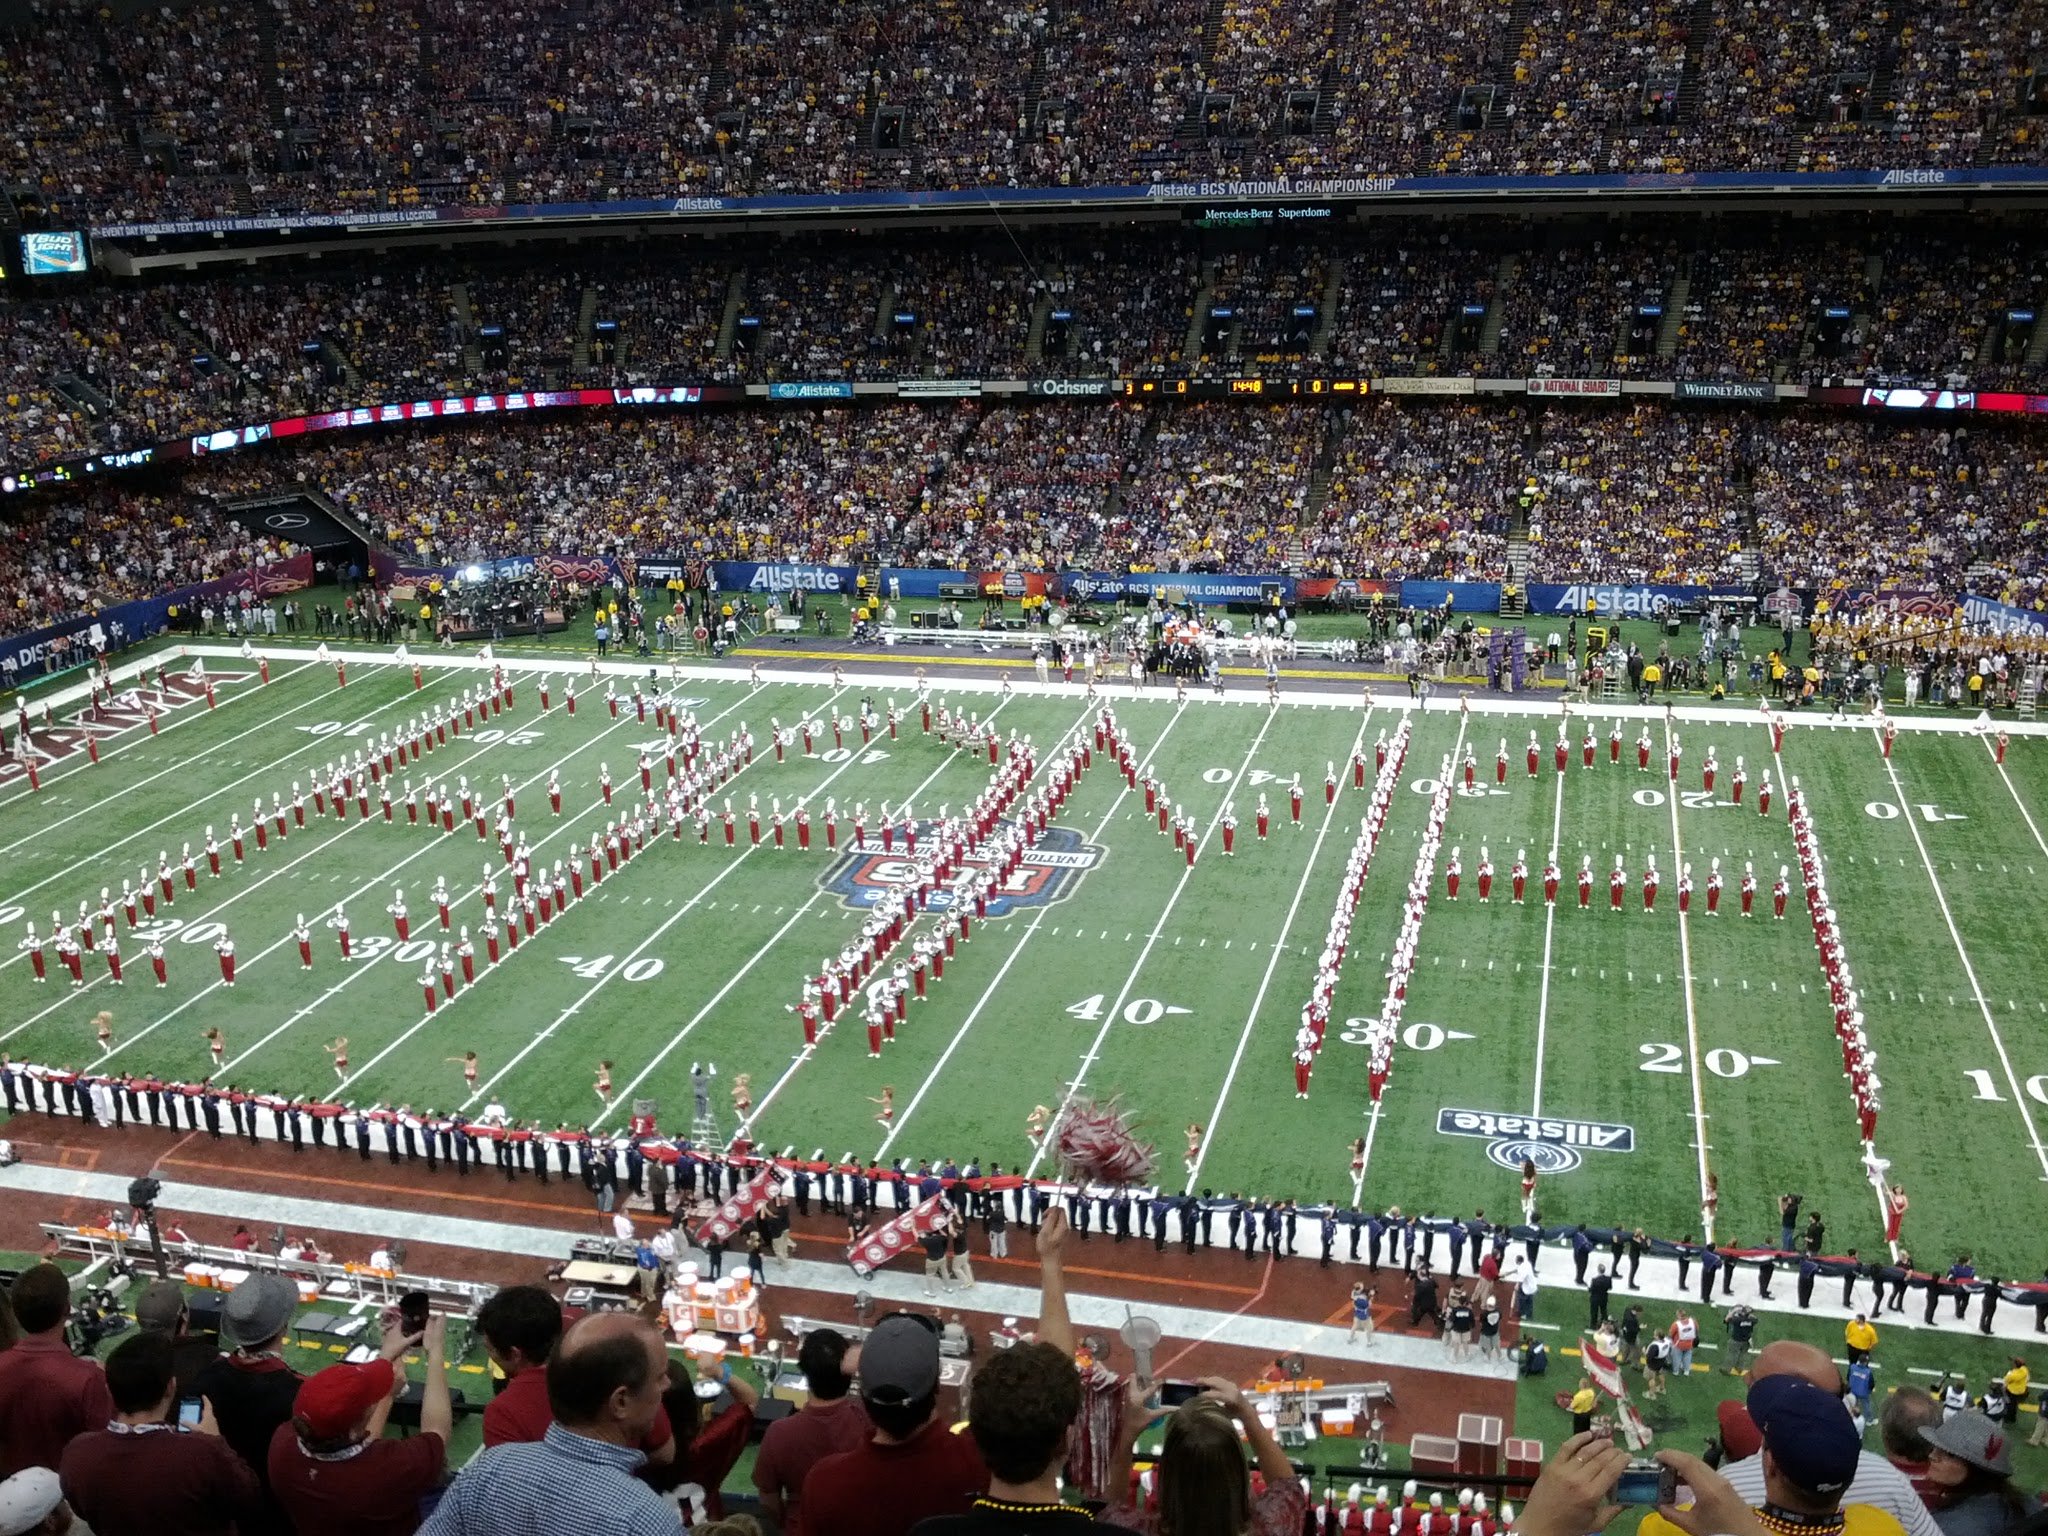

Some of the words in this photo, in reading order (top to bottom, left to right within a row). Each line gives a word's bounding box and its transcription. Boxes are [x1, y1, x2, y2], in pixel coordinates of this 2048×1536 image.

[1881, 169, 1945, 184] Allstate
[1146, 183, 1197, 197] Allstate
[1200, 182, 1226, 195] BCS
[1228, 180, 1293, 195] NATIONAL
[1295, 178, 1396, 193] CHAMPIONSHIP
[674, 197, 723, 210] Allstate
[1205, 208, 1273, 219] Mercedes-Benz
[1278, 207, 1331, 219] Superdome
[176, 222, 194, 233] TEXT
[195, 222, 205, 232] TO
[334, 214, 368, 225] FOLLOWED
[369, 214, 379, 223] BY
[406, 210, 437, 221] LOCATION
[36, 234, 72, 244] BUD
[32, 243, 74, 252] LIGHT
[798, 384, 840, 396] Allstate
[1043, 379, 1104, 395] Ochsner
[1126, 384, 1133, 395] 3
[1177, 381, 1186, 393] 0
[1312, 381, 1321, 393] 0
[1359, 383, 1367, 394] 3
[1543, 380, 1580, 393] NATIONAL
[1582, 380, 1608, 393] GUARD
[1684, 384, 1732, 397] WHITNEY
[1733, 385, 1763, 397] BANK
[638, 565, 682, 579] ESPN
[749, 565, 840, 590] Allstate
[1204, 584, 1286, 597] CHAMPIONP
[1555, 586, 1669, 613] Allstate
[1767, 597, 1799, 610] BCS
[310, 722, 375, 736] 10
[473, 730, 545, 745] 20
[821, 748, 891, 764] 40
[1203, 768, 1277, 786] 40
[1410, 779, 1488, 797] 30
[1632, 790, 1714, 808] 20
[1864, 802, 1945, 821] 10
[130, 919, 227, 943] 20
[350, 936, 437, 962] 30
[571, 955, 664, 981] 40
[1065, 994, 1164, 1024] 40
[1340, 1018, 1445, 1050] 30
[1639, 1043, 1749, 1077] 20
[1454, 1112, 1628, 1147] Allstate
